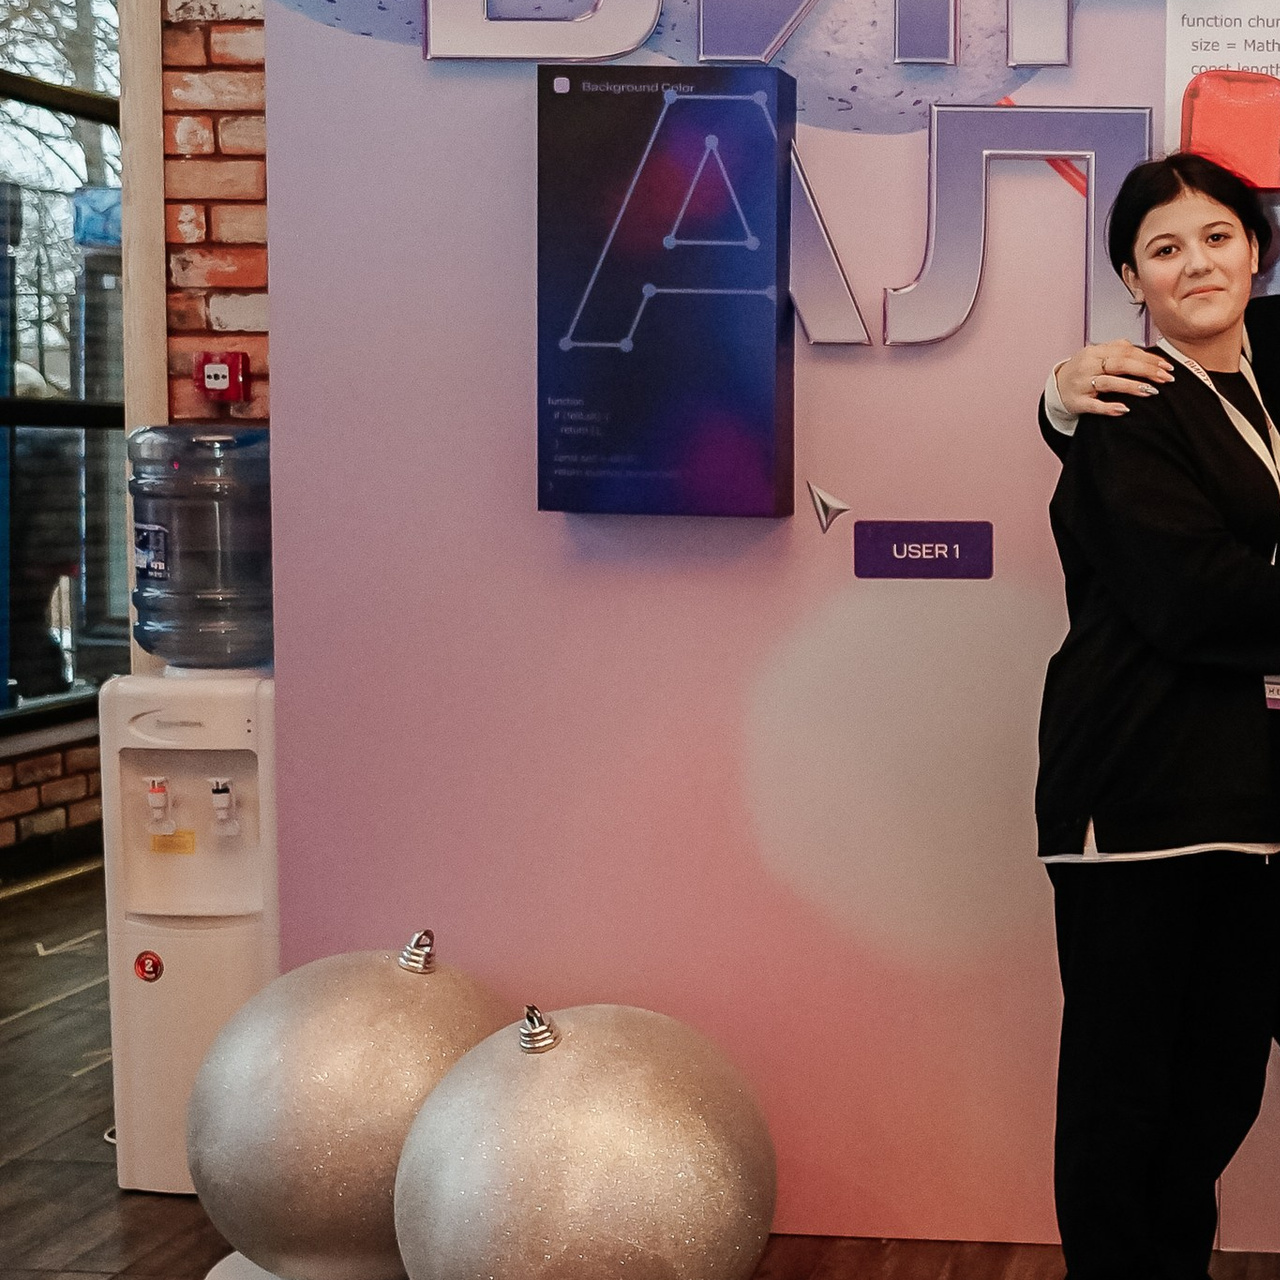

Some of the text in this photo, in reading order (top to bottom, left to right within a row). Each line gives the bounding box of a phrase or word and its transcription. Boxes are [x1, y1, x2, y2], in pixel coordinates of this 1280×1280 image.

[1181, 14, 1243, 28] function
[1191, 38, 1221, 51] size
[582, 81, 696, 95] Background Color
[892, 543, 960, 560] USER 1
